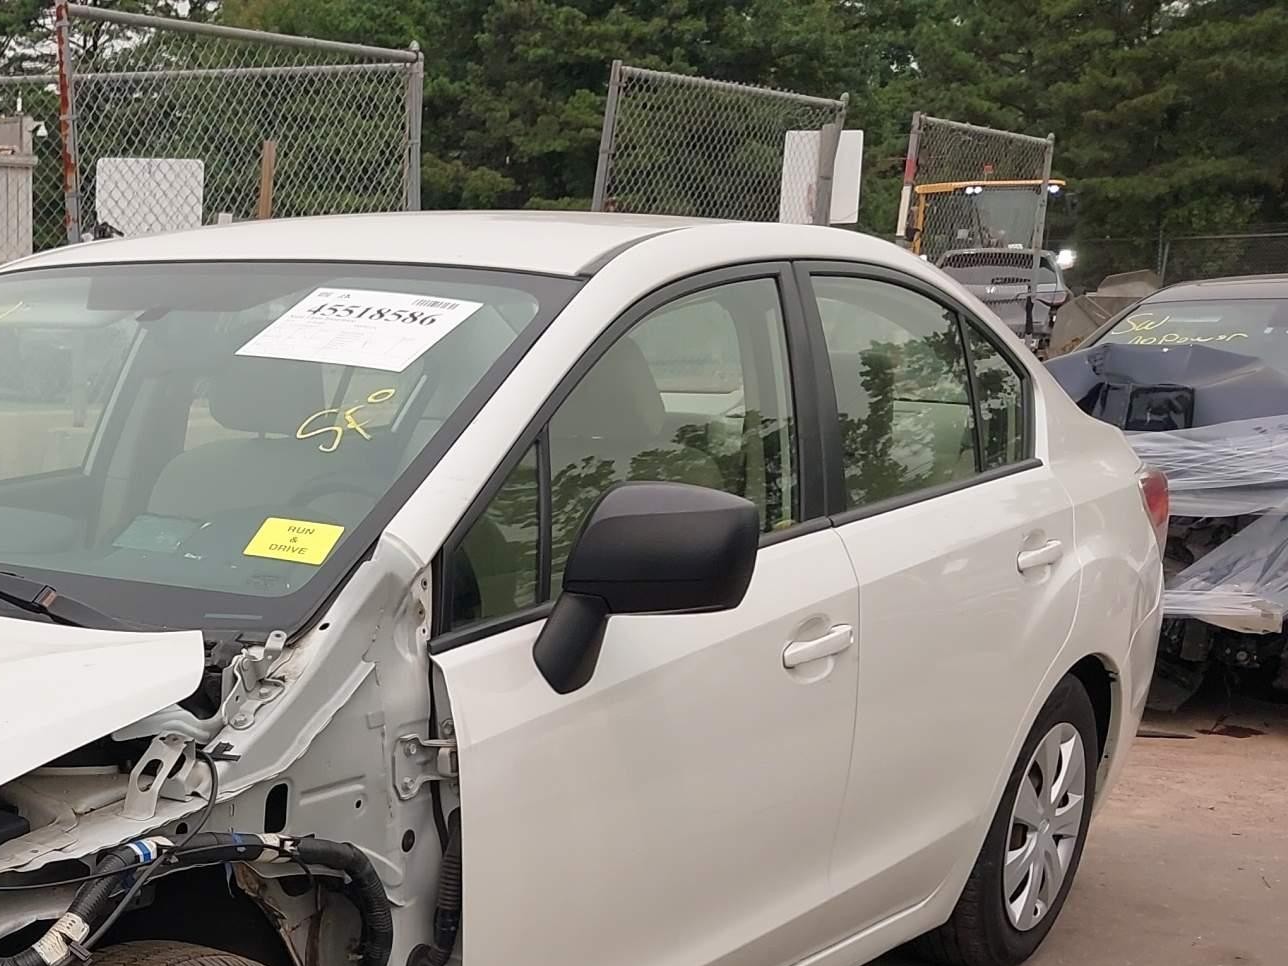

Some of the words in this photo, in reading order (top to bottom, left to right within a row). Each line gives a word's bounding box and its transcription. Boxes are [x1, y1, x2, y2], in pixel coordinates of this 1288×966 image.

[307, 303, 443, 326] 45518586
[288, 526, 316, 535] RUN
[268, 543, 309, 555] DRIVE
